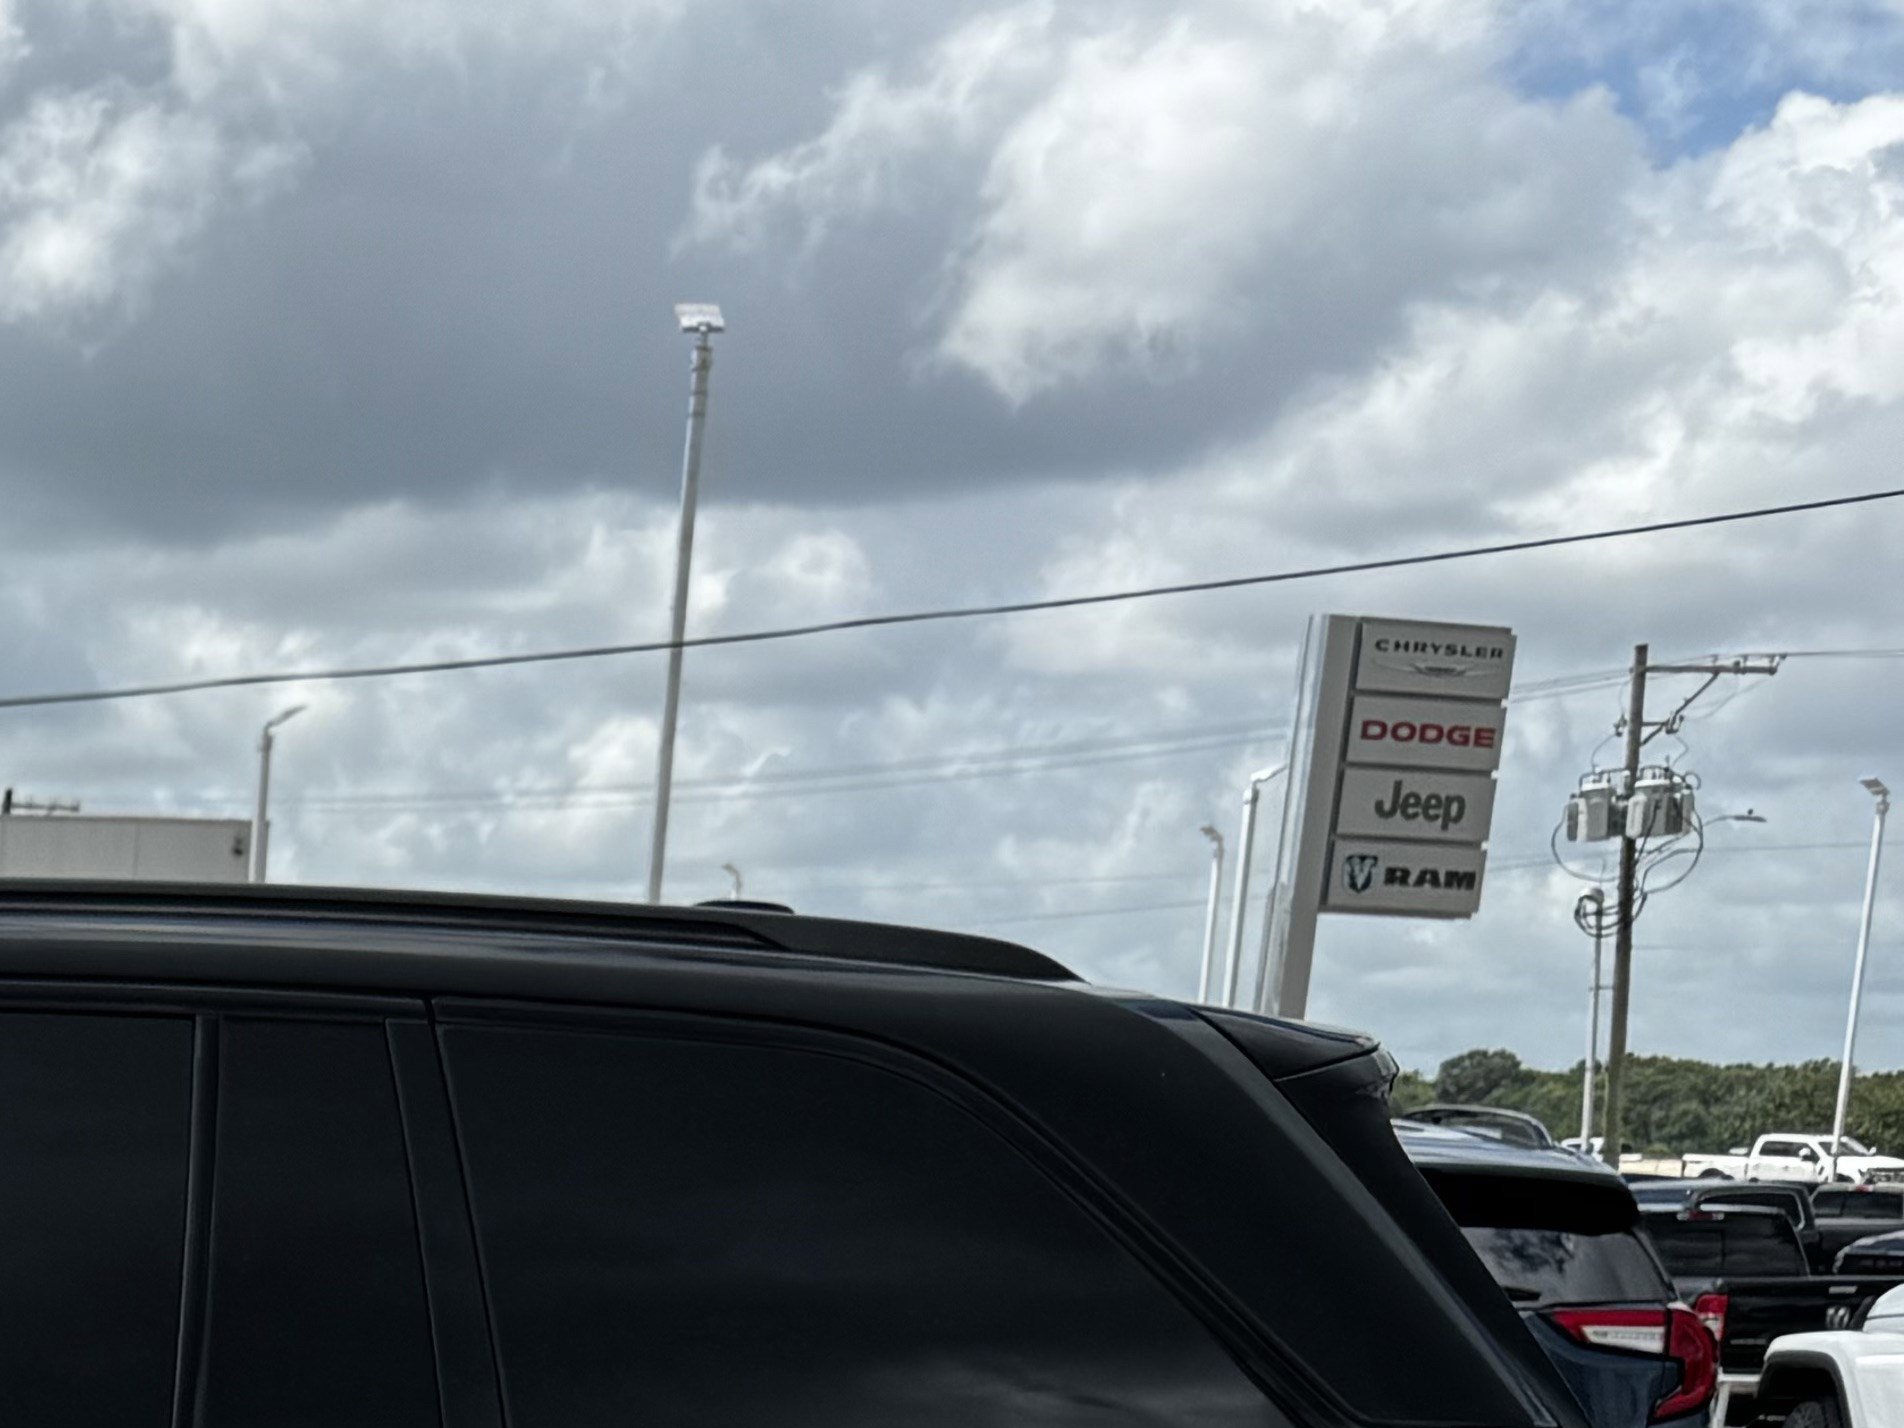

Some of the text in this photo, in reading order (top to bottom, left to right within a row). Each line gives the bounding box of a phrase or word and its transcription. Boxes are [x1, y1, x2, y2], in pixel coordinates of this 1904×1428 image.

[1375, 639, 1504, 659] CHRYSLER
[1360, 719, 1496, 749] DODGE
[1374, 780, 1466, 831] Jeep
[1384, 866, 1476, 891] RAM
